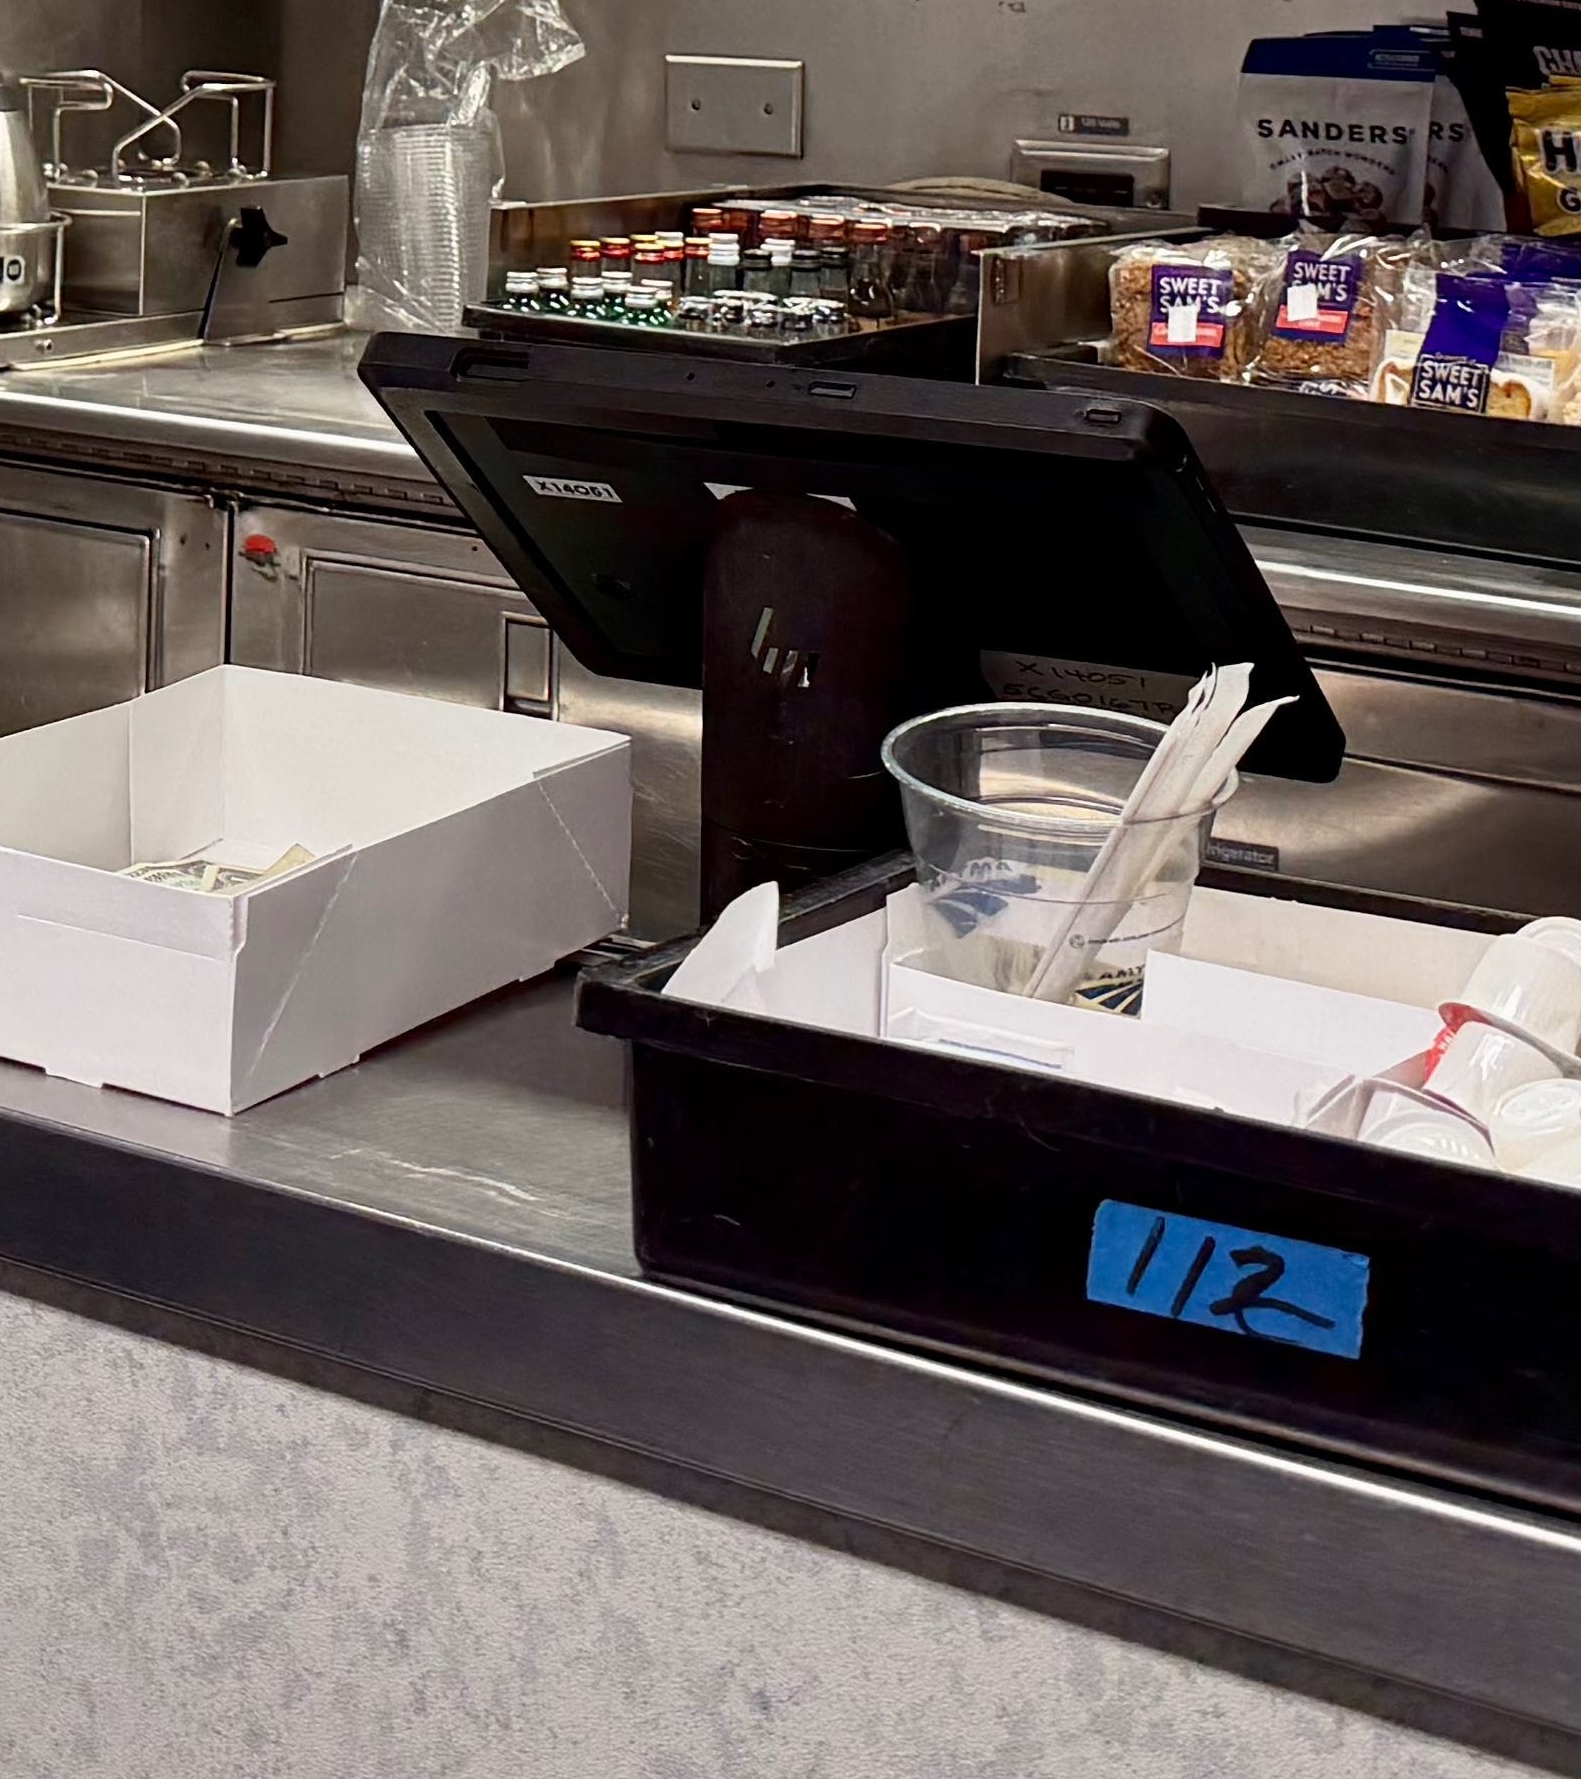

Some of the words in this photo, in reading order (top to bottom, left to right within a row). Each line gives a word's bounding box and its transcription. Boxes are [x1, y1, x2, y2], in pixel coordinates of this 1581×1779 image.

[1257, 118, 1408, 145] SANDERS
[1293, 260, 1351, 283] SWEET
[1159, 276, 1223, 296] SWEET
[1422, 359, 1480, 385] SWEET
[1417, 379, 1480, 408] SAM'S
[1126, 1215, 1337, 1345] 112
